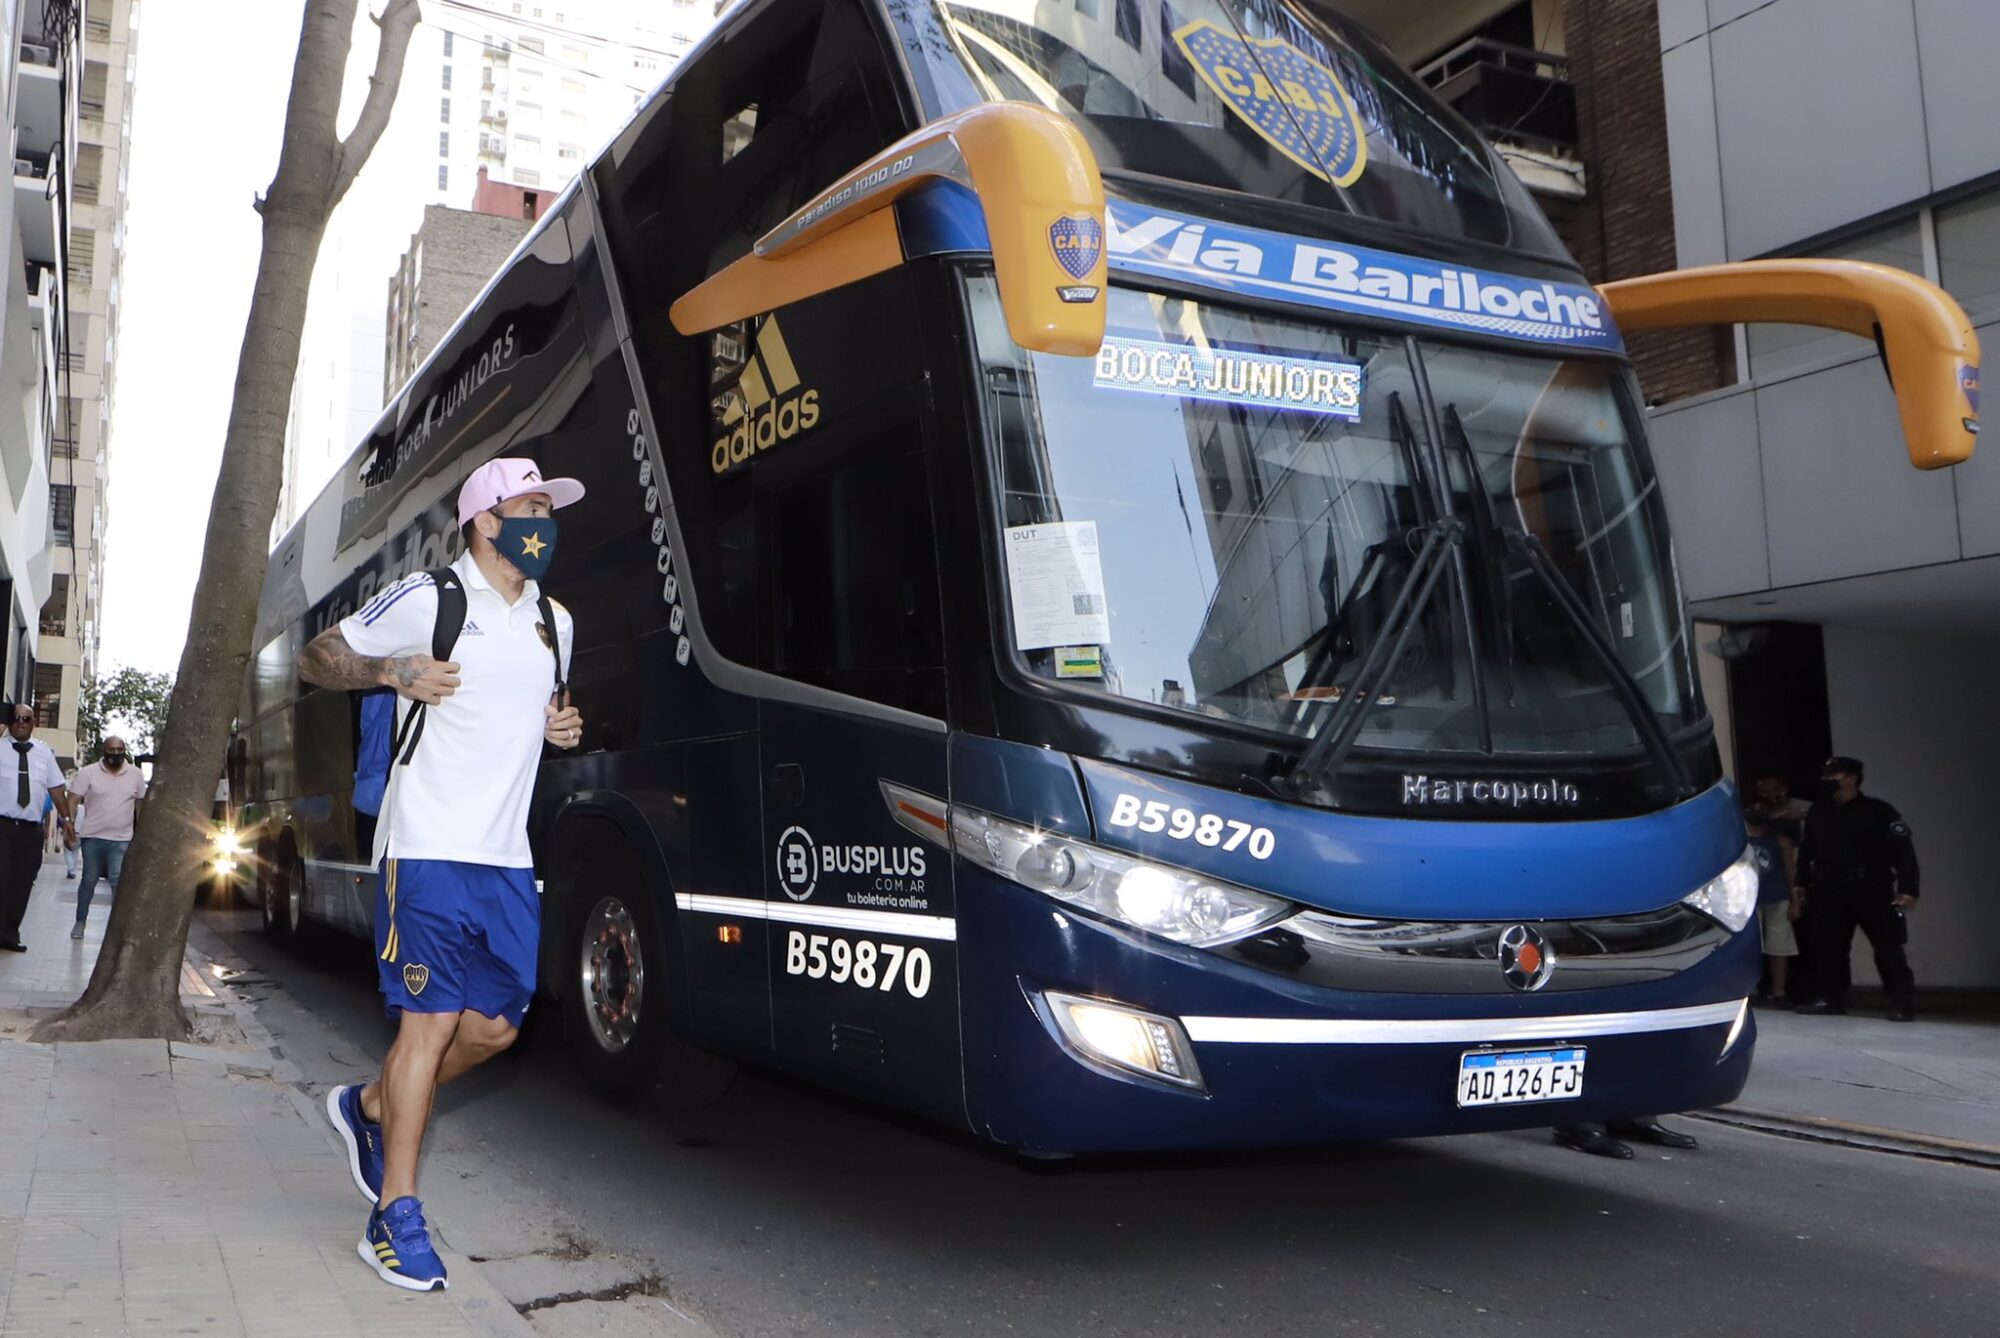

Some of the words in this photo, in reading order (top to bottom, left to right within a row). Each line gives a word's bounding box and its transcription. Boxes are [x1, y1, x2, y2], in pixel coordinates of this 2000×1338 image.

[1214, 65, 1343, 119] CABJ
[797, 187, 851, 230] Paradiso
[1055, 234, 1100, 250] CABJ
[1104, 206, 1263, 276] Via
[1291, 244, 1602, 328] Bariloche
[437, 323, 515, 428] JUNIORS
[1095, 344, 1197, 389] BOCA
[1203, 356, 1360, 408] JUNIORS
[711, 389, 820, 474] adidas
[1012, 529, 1038, 541] DUT
[1402, 775, 1580, 807] Marcopolo
[1109, 793, 1276, 860] B59870
[822, 845, 927, 877] BUSPLUS
[847, 892, 857, 904] tu
[899, 896, 928, 910] online
[786, 930, 932, 999] B59870
[1467, 1070, 1495, 1101] AD
[1502, 1066, 1543, 1098] 126
[1550, 1064, 1578, 1094] FJ
